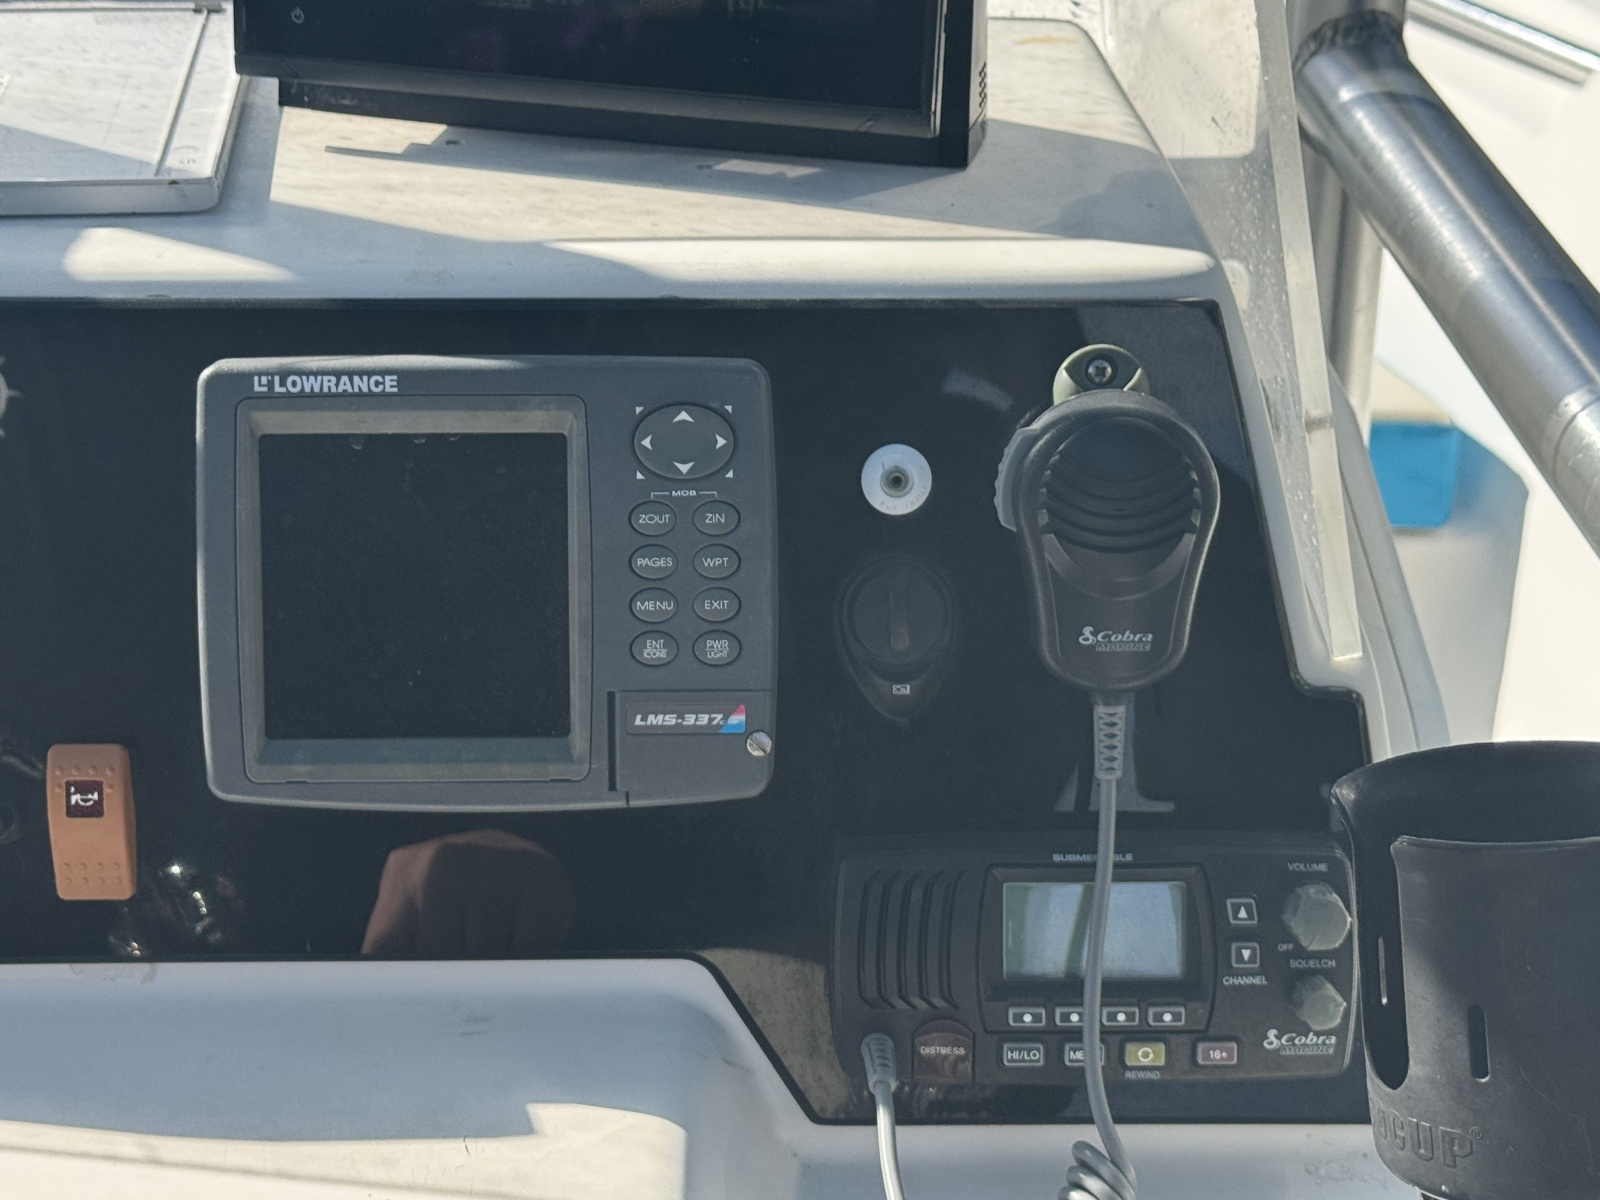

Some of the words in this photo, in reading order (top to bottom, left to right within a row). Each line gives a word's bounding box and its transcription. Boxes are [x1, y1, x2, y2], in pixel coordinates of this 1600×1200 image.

[274, 375, 398, 393] LOWRANCE
[639, 514, 670, 524] ZOUT
[705, 513, 725, 523] ZIN
[637, 557, 673, 567] PAGES
[702, 557, 729, 567] WPT
[637, 601, 674, 610] MENU
[704, 600, 729, 610] EXIT
[1097, 630, 1153, 641] Cobra
[647, 640, 664, 649] ENT
[706, 640, 729, 649] PWR
[643, 650, 667, 658] ICONS
[707, 650, 728, 658] LIGHT
[1287, 862, 1328, 871] VOLUME
[1277, 943, 1294, 951] OFF
[1289, 959, 1336, 968] SQUELCH
[1222, 975, 1268, 985] CHANNEL
[1281, 1031, 1337, 1045] Cobra
[920, 1045, 965, 1055] DISTRESS
[1209, 1049, 1228, 1060] 16+
[1007, 1051, 1040, 1060] HI/LO
[1125, 1071, 1161, 1079] REWIND
